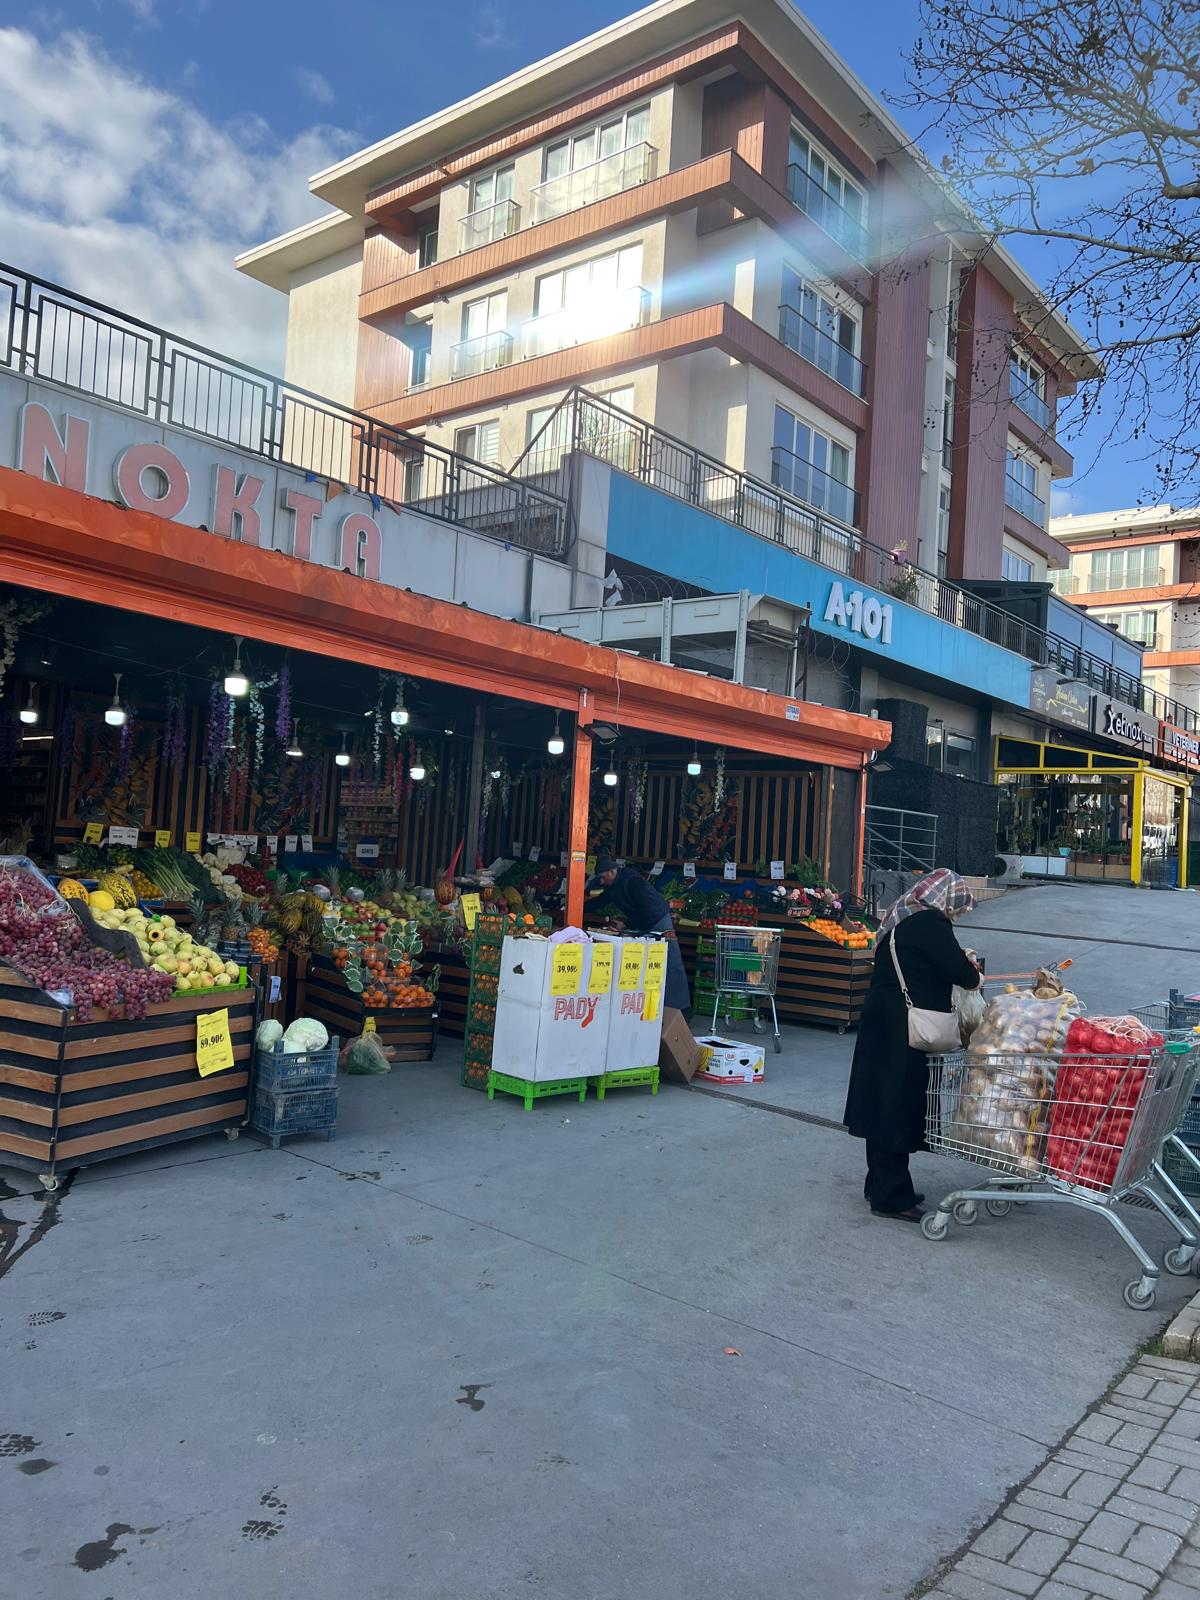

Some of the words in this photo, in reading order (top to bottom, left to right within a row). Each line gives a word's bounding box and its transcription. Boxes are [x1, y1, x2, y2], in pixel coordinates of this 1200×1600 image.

[17, 402, 382, 581] NOKTA
[554, 997, 599, 1028] PADY
[621, 993, 646, 1020] PAD
